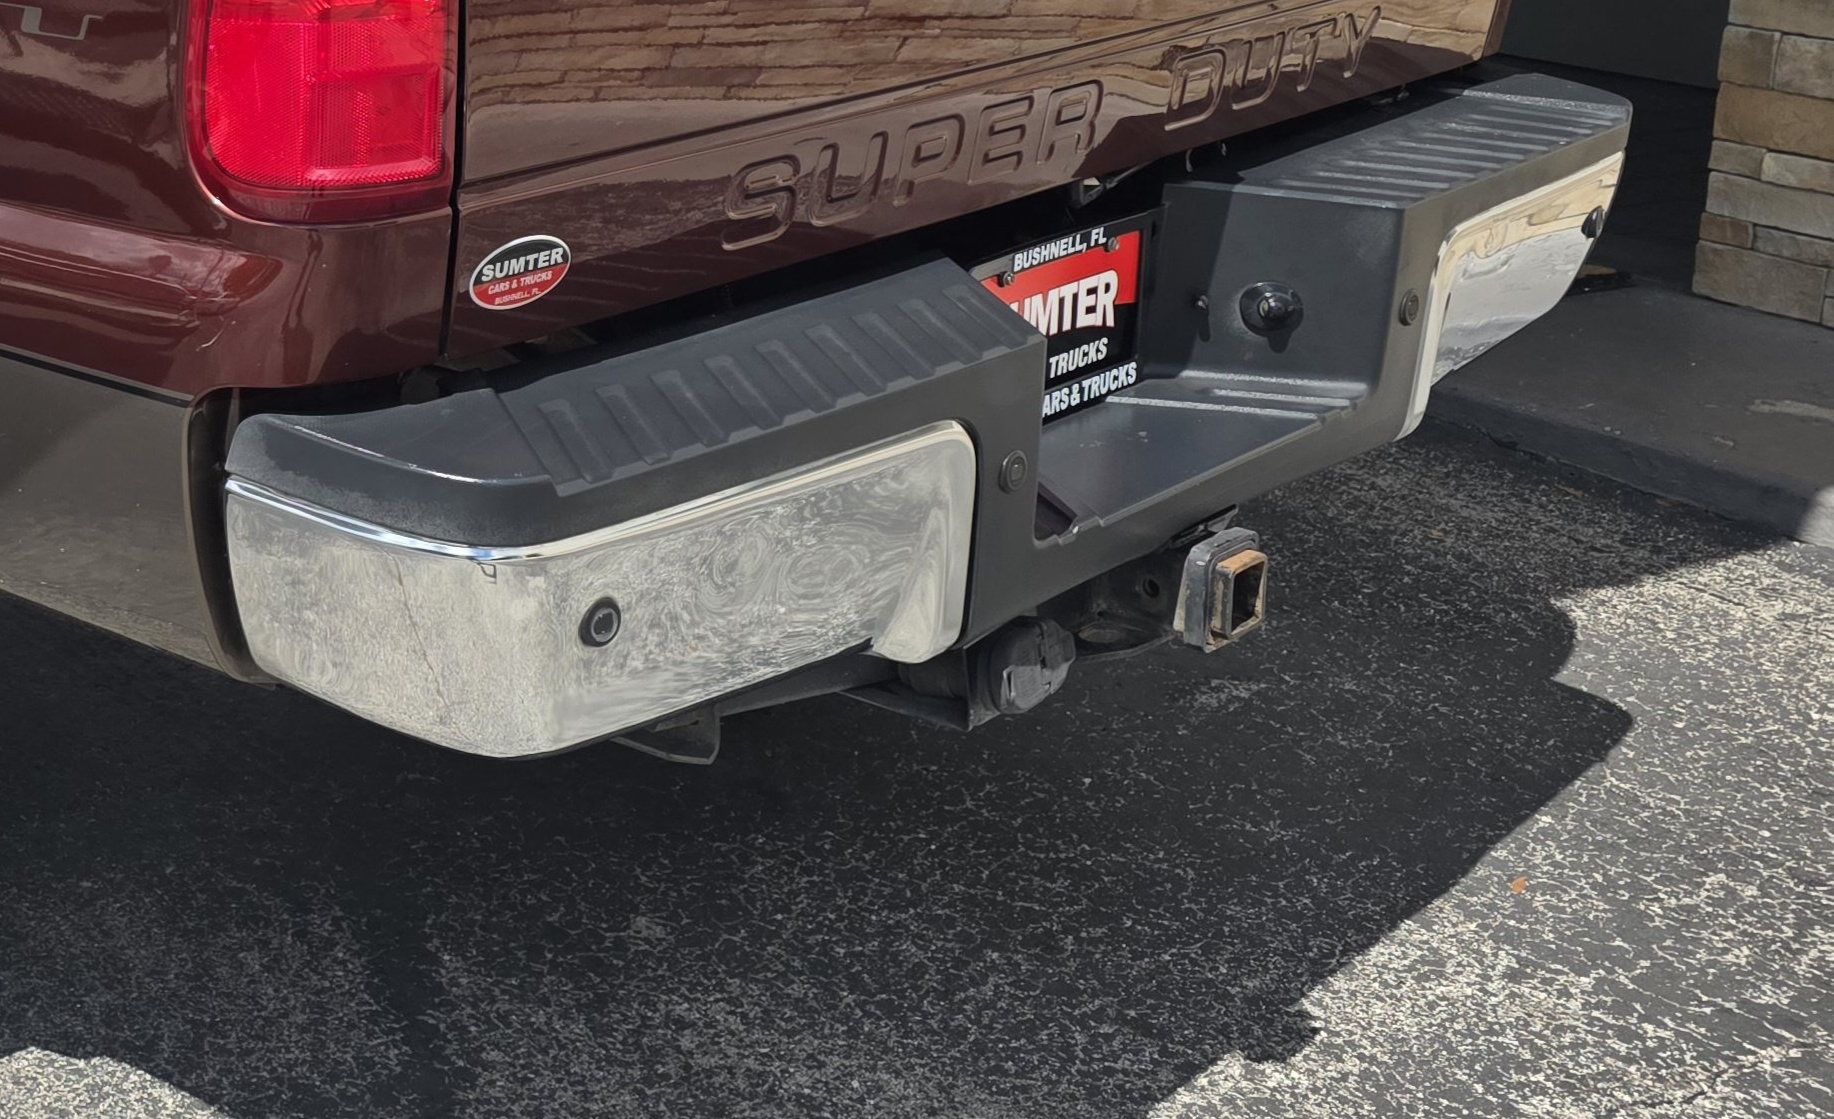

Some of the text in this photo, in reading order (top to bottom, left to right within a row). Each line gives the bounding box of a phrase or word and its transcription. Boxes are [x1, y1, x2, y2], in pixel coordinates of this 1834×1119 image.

[721, 5, 1382, 252] SUPER DUTY
[481, 247, 564, 282] SUMTER
[1013, 226, 1107, 272] BUSHNELL, FL
[488, 270, 553, 295] CARS & TRUCKS
[1009, 269, 1119, 337] MTER
[1049, 337, 1109, 379] TRUCKS
[1042, 361, 1138, 418] ARS & TRUCKS
